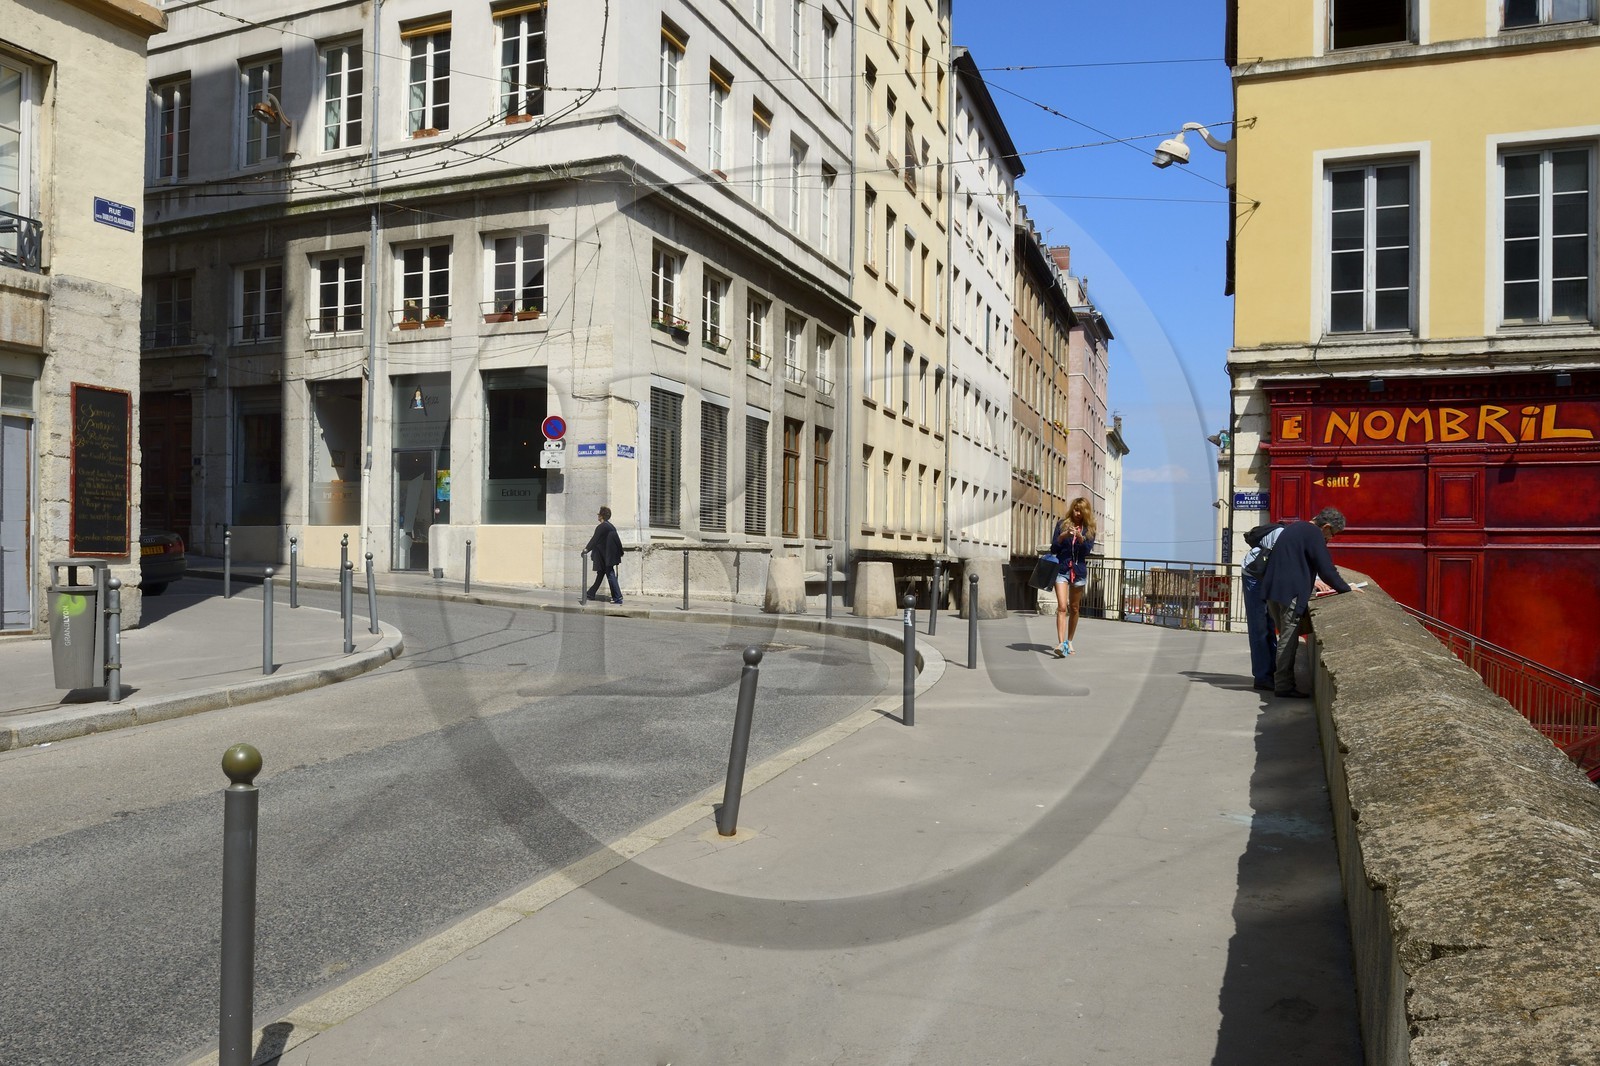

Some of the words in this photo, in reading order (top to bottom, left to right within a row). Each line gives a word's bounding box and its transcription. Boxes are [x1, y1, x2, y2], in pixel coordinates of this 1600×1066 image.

[108, 207, 122, 217] RUE
[1326, 476, 1349, 488] SALLE
[1353, 472, 1361, 488] 2
